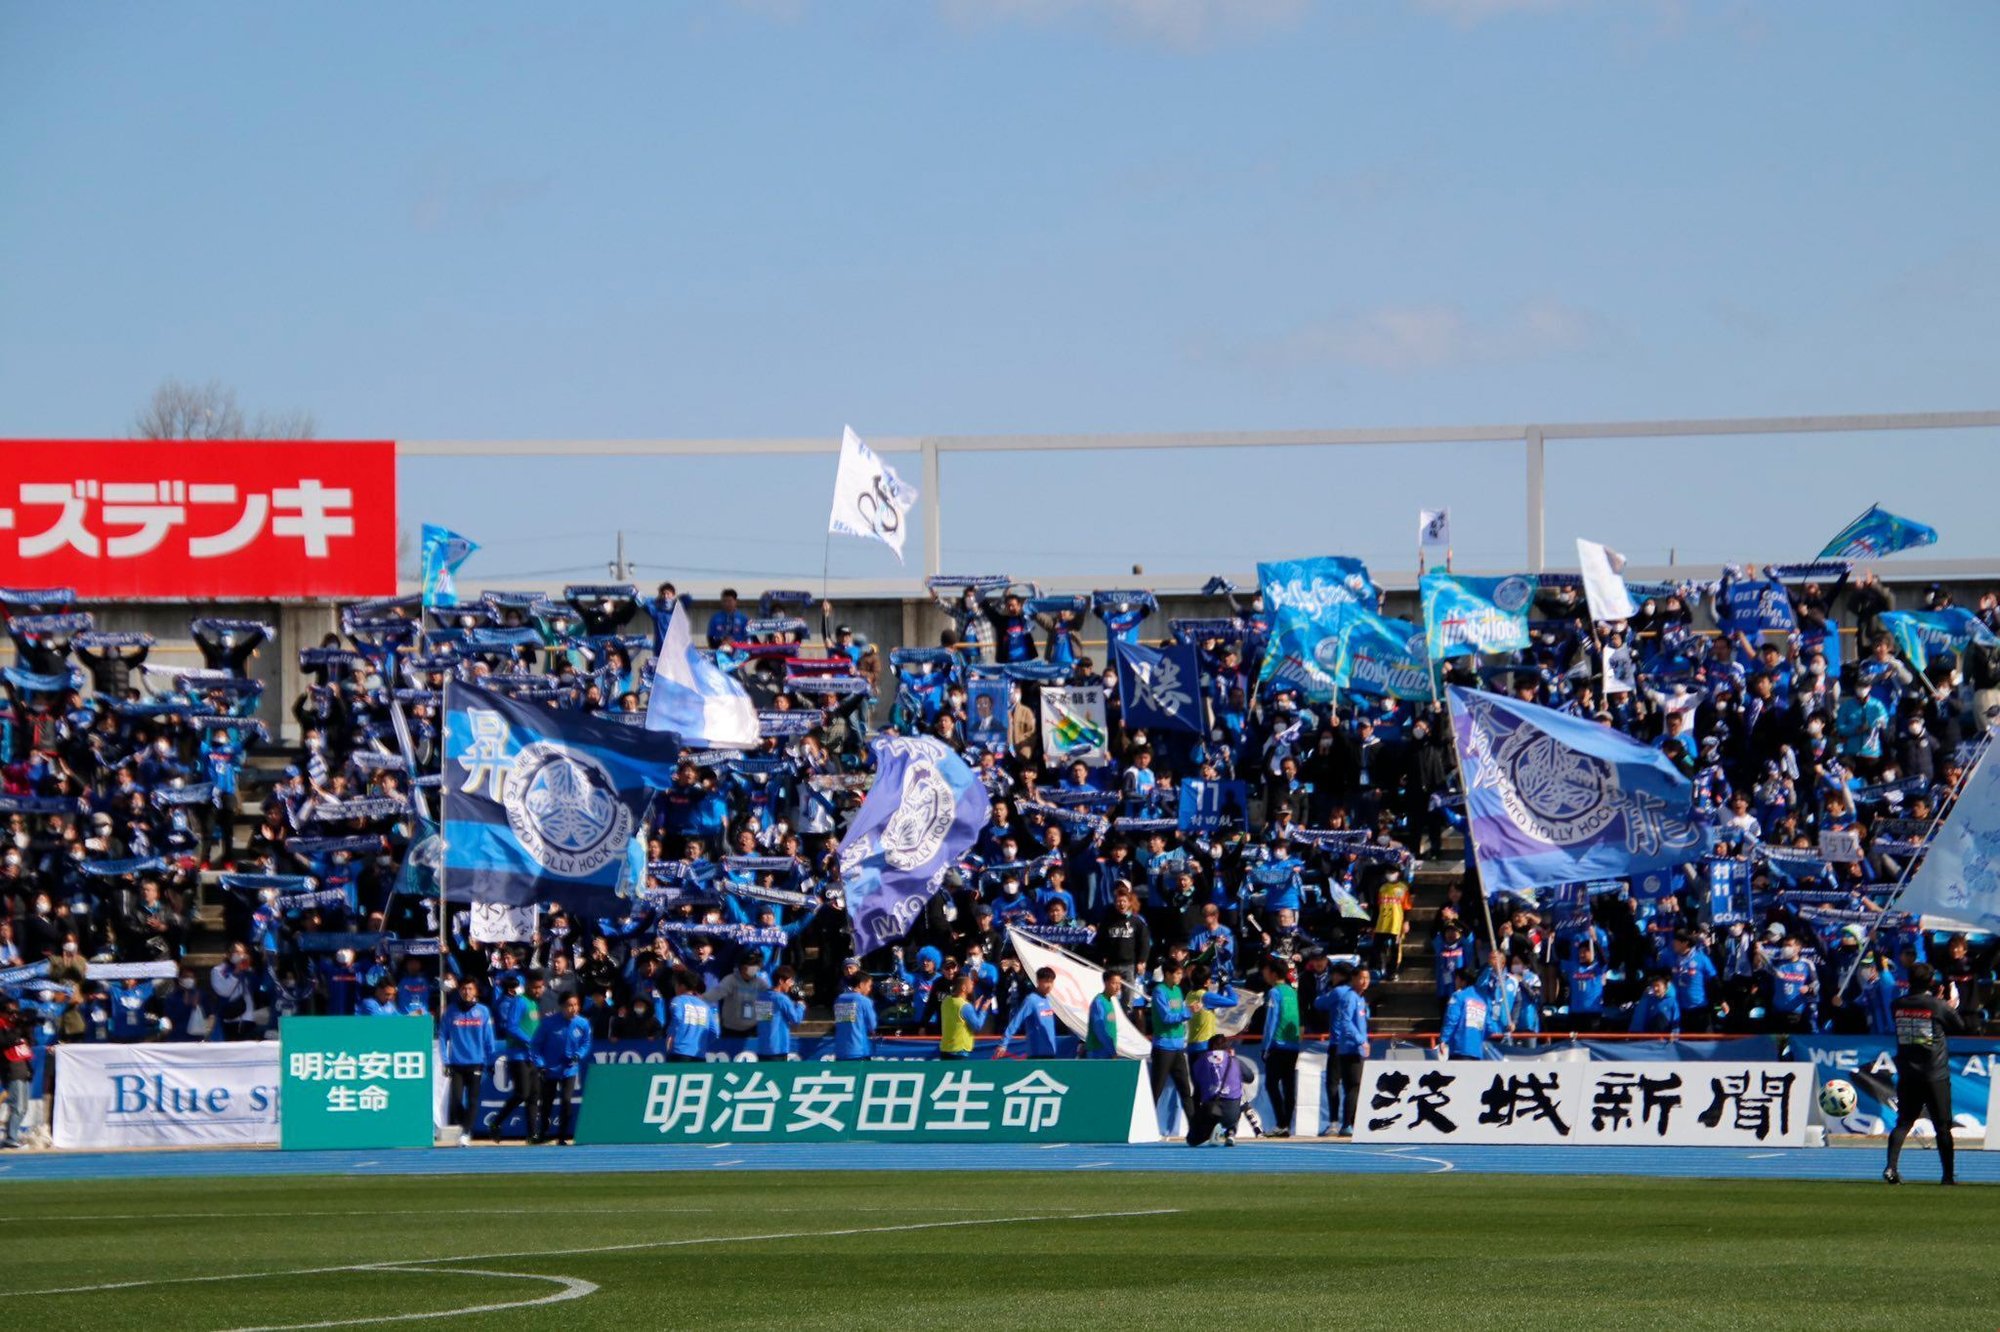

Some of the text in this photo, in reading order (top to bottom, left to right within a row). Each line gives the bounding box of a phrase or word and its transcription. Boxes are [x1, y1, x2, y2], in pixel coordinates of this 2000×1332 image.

[0, 479, 354, 558] ズデンキ
[1128, 656, 1193, 717] 勝
[929, 807, 952, 844] HOCK
[1530, 822, 1574, 842] HOLLY
[579, 843, 612, 871] HOCK
[289, 1051, 425, 1081] 明治安田
[1808, 1047, 1859, 1073] WE
[107, 1072, 231, 1114] Blue
[326, 1085, 390, 1112] 生命
[642, 1069, 1070, 1135] 明治安田生命
[1368, 1068, 1797, 1142] 茨城新聞
